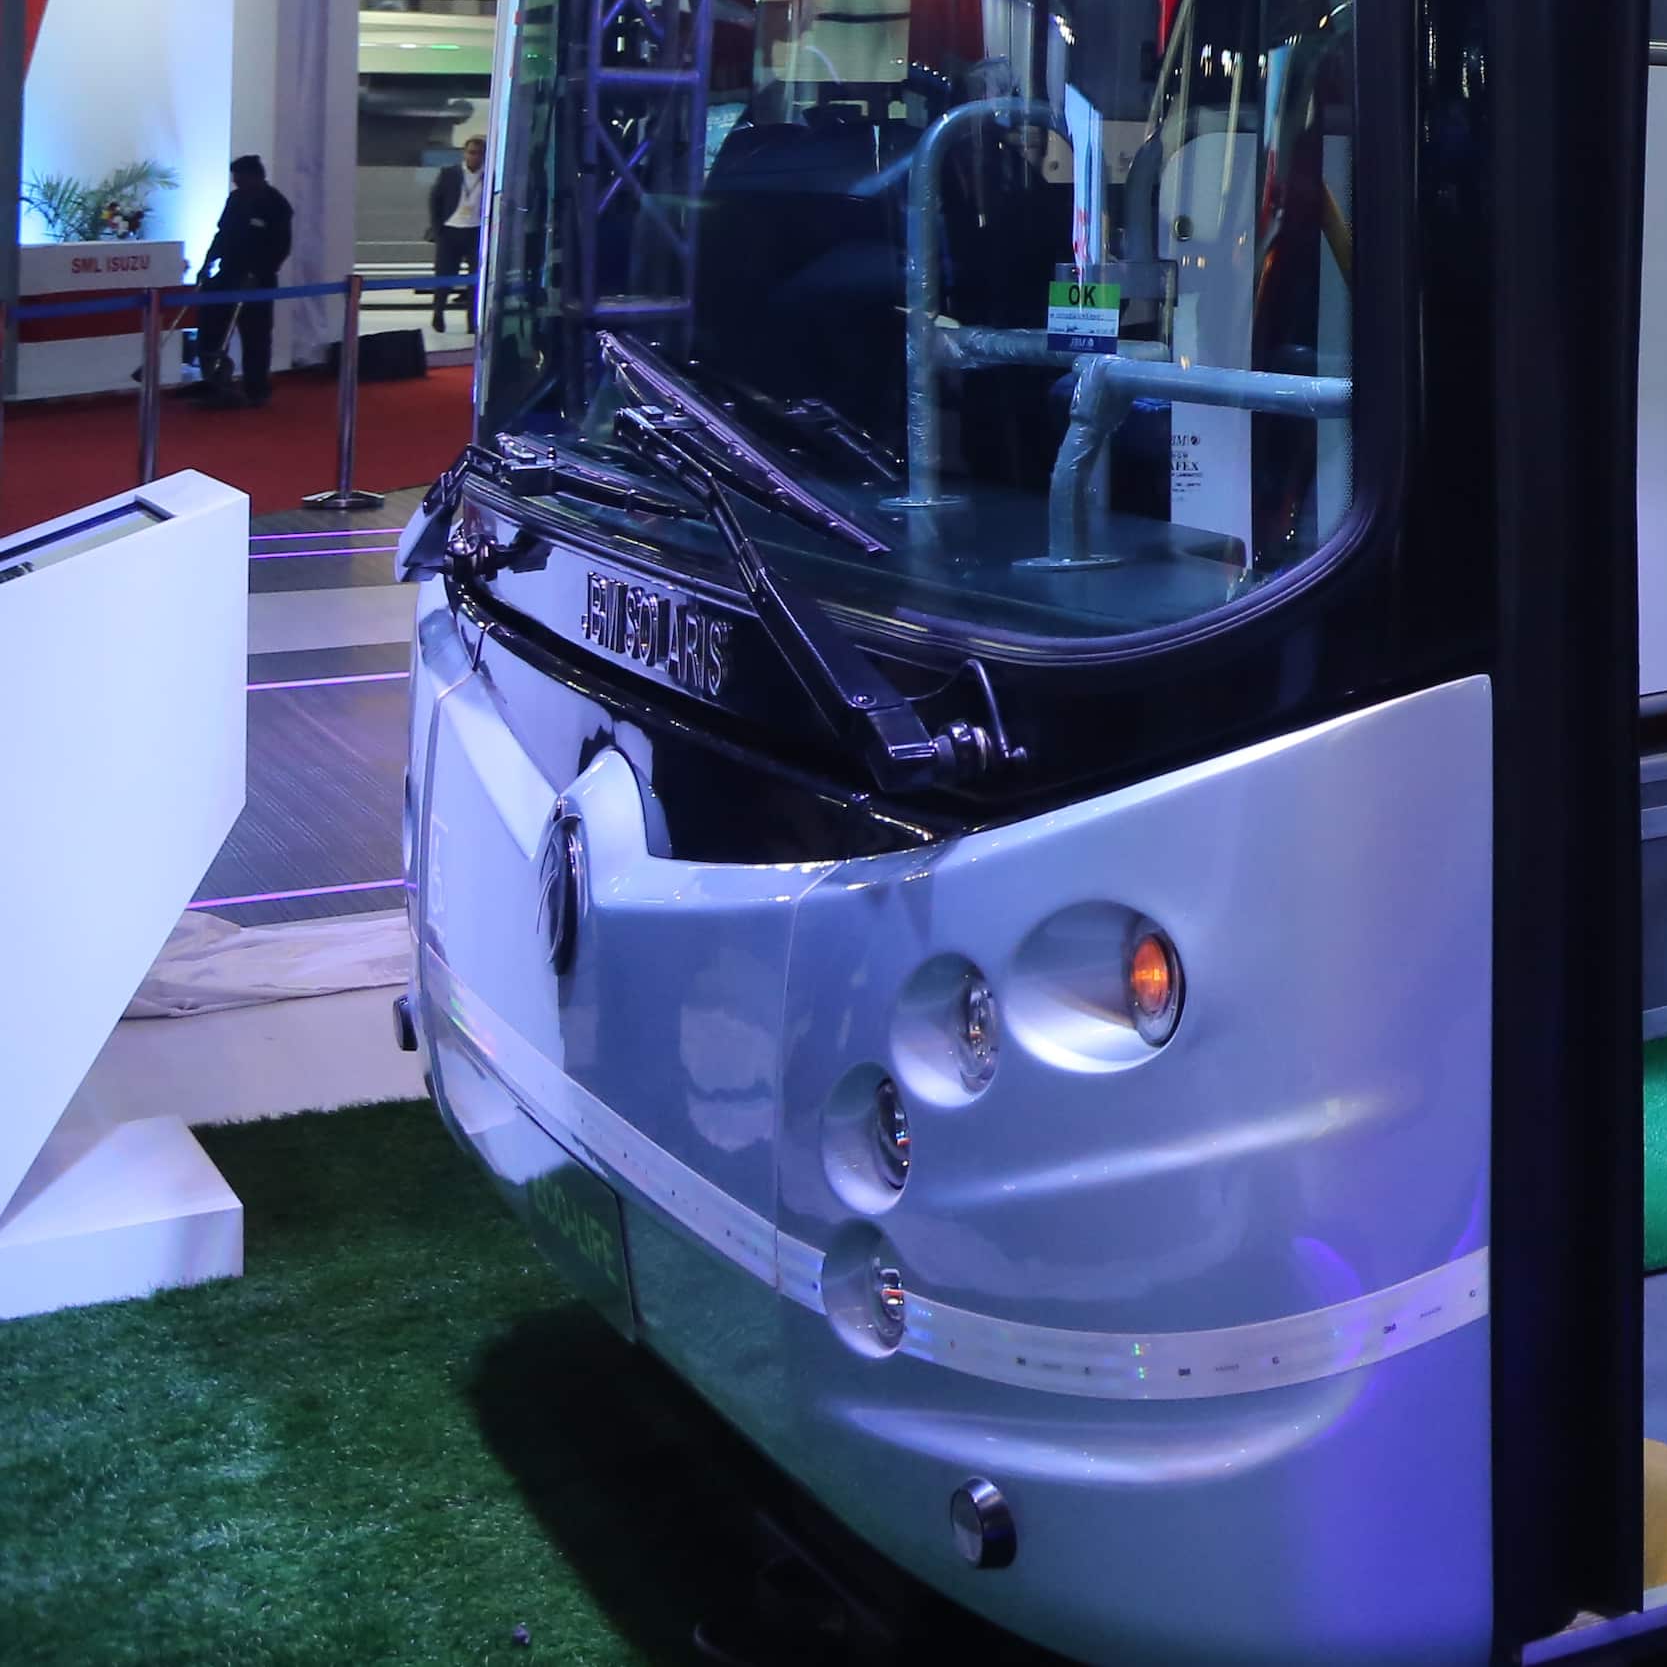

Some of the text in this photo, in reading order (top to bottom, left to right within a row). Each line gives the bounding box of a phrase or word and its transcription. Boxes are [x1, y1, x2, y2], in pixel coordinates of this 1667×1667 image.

[72, 254, 150, 273] SML ISUZU
[1068, 284, 1096, 307] OK
